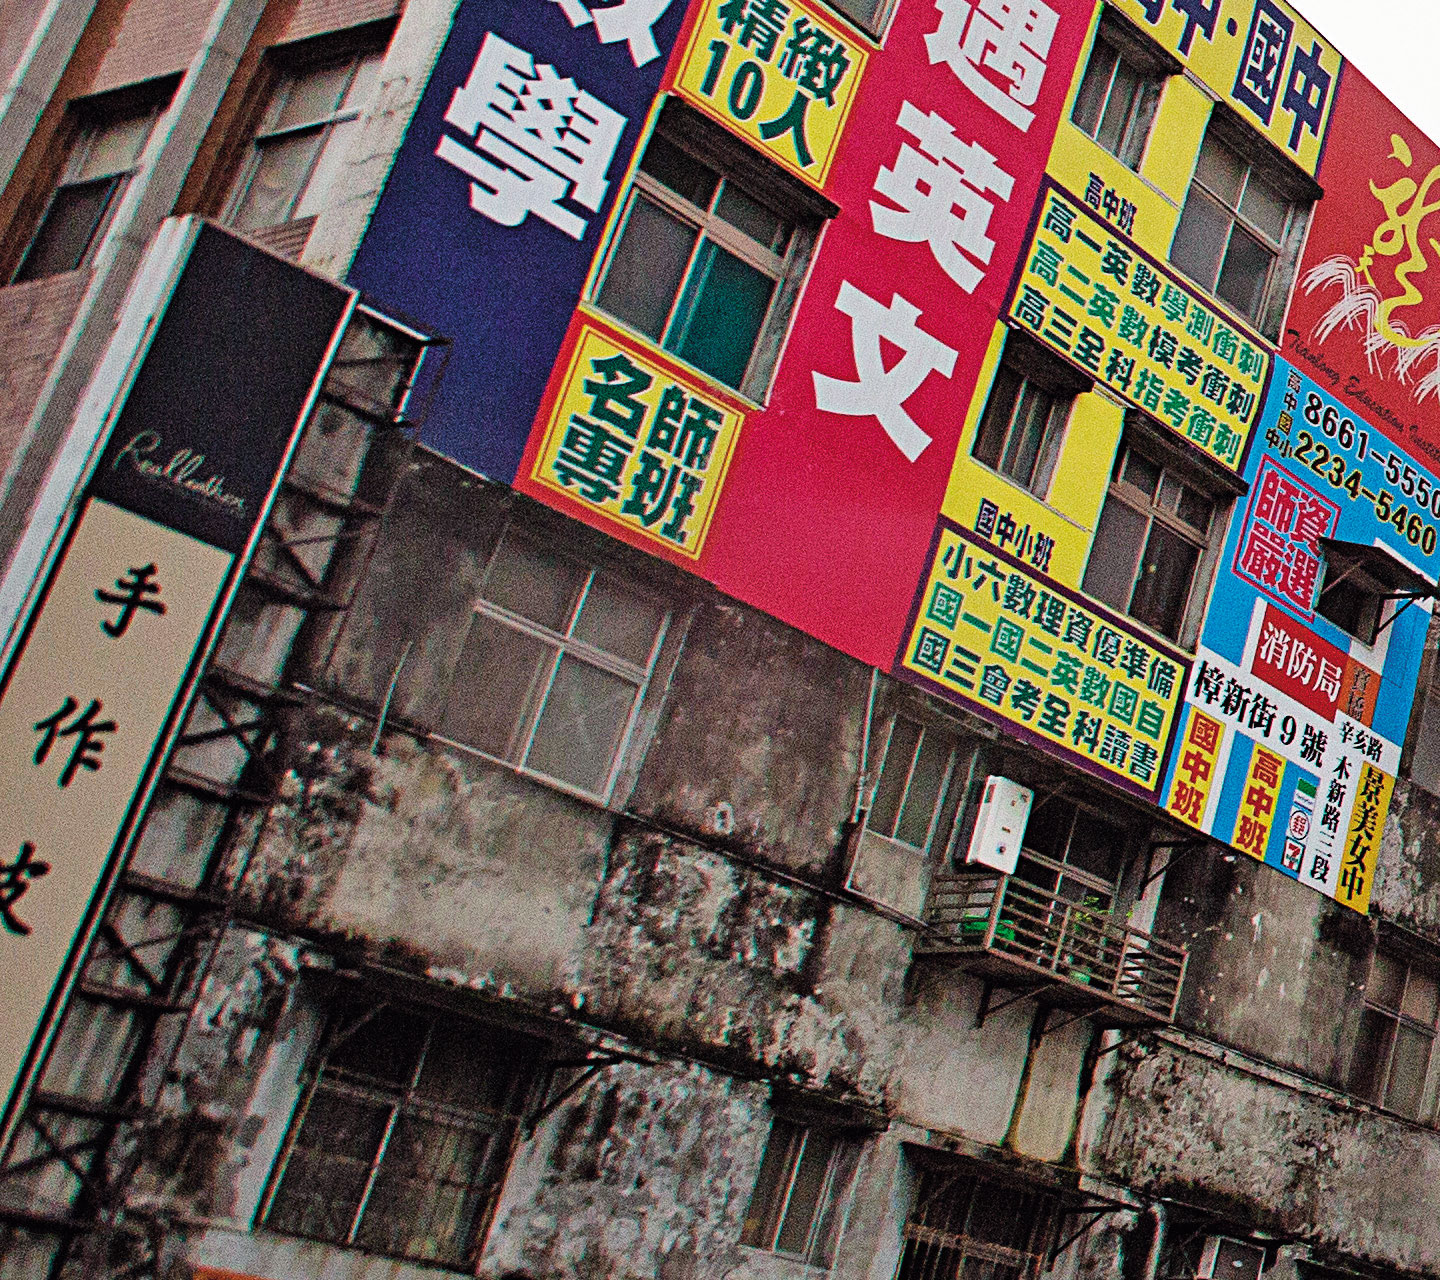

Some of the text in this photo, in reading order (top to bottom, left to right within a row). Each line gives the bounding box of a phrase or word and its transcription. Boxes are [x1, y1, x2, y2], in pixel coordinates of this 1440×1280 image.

[698, 39, 817, 170] 10人
[1084, 171, 1138, 237] 高中班
[1028, 239, 1257, 425] 高二英數模考衝刺
[1043, 196, 1265, 384] 高一英數學測衝刺
[583, 352, 726, 473] 名師
[1013, 284, 1243, 464] 高三全科指考衝刺
[553, 415, 707, 543] 專班
[974, 497, 1055, 574] 國中小班
[1254, 468, 1332, 556] 師資
[1293, 430, 1438, 556] 2234-5460
[941, 542, 1179, 700] 小六數理資優準備
[1241, 521, 1320, 611] 嚴選
[911, 626, 1159, 782] 國三會考全科讀書
[925, 581, 1167, 740] 國一國二英數國自
[1259, 622, 1342, 704] 消防局
[1170, 712, 1222, 826] 國中班
[1236, 748, 1282, 858] 高中班
[1339, 720, 1384, 763] 辛亥路
[1310, 755, 1352, 884] 木新路三段
[1340, 767, 1384, 901] 景美女中
